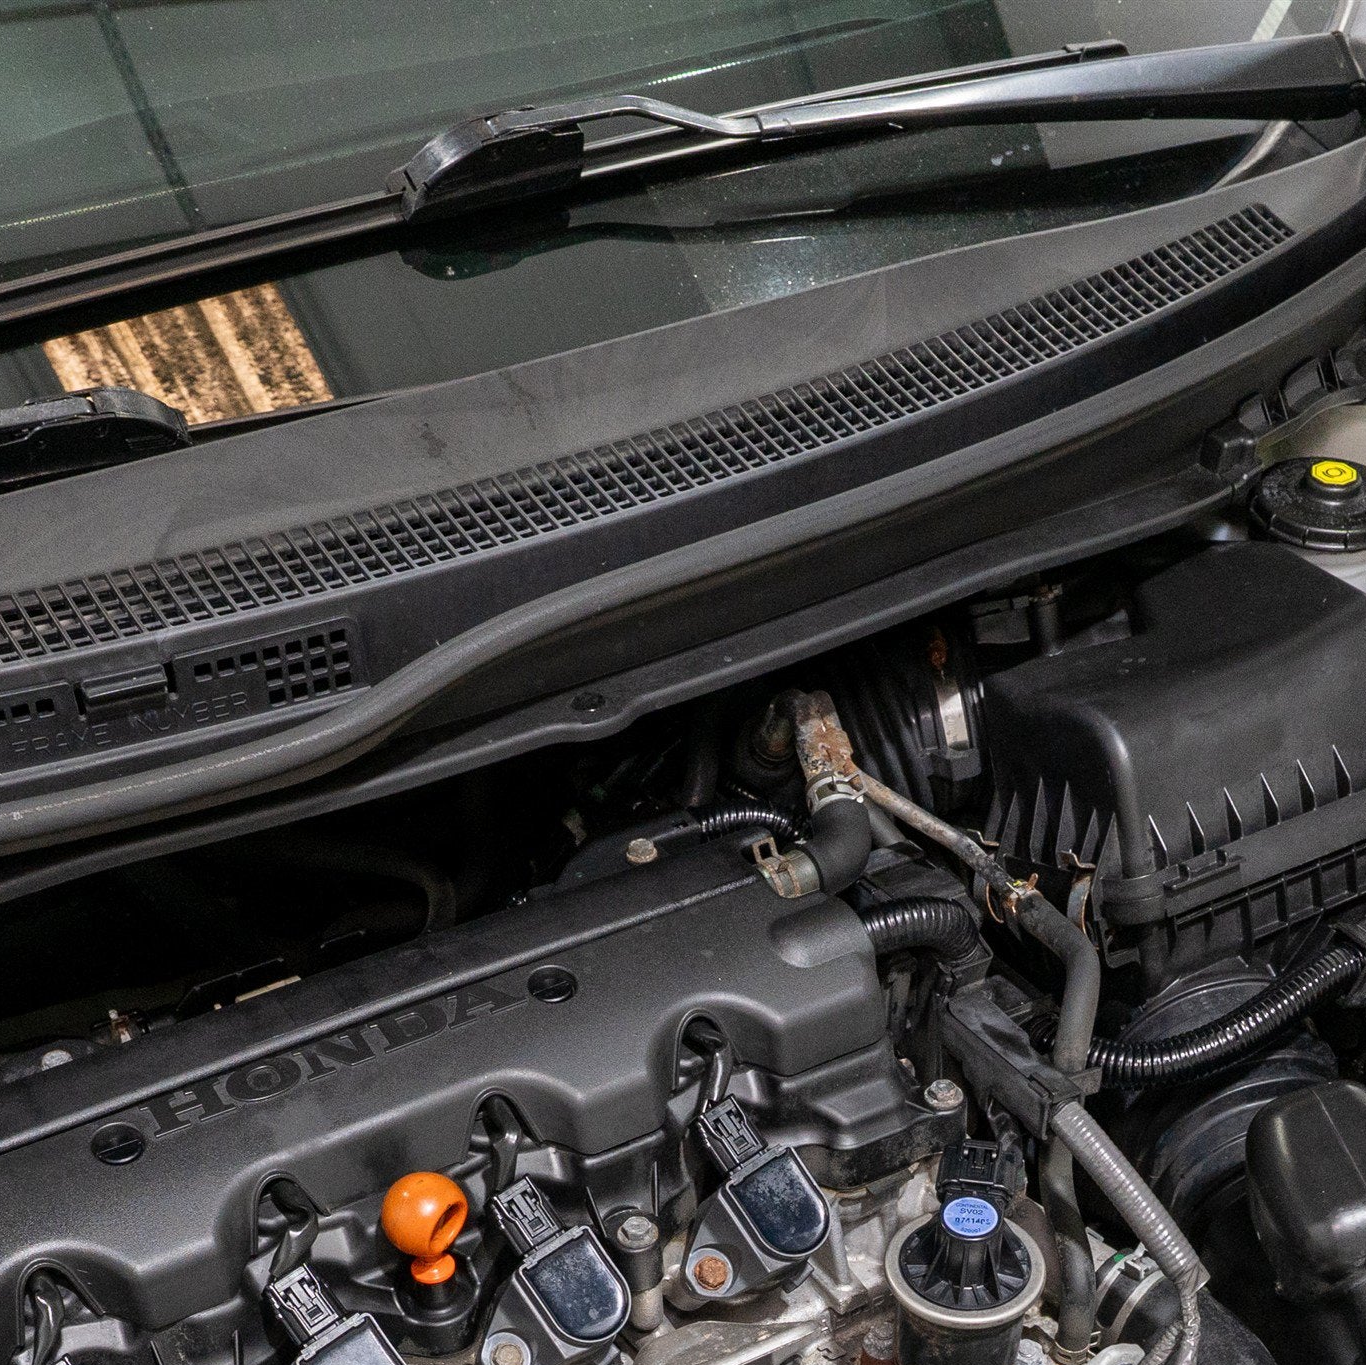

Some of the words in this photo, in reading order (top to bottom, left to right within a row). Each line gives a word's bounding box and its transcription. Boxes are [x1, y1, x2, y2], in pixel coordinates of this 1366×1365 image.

[11, 723, 112, 757] FRAME
[140, 985, 528, 1139] HONDA
[959, 1207, 984, 1216] SV02
